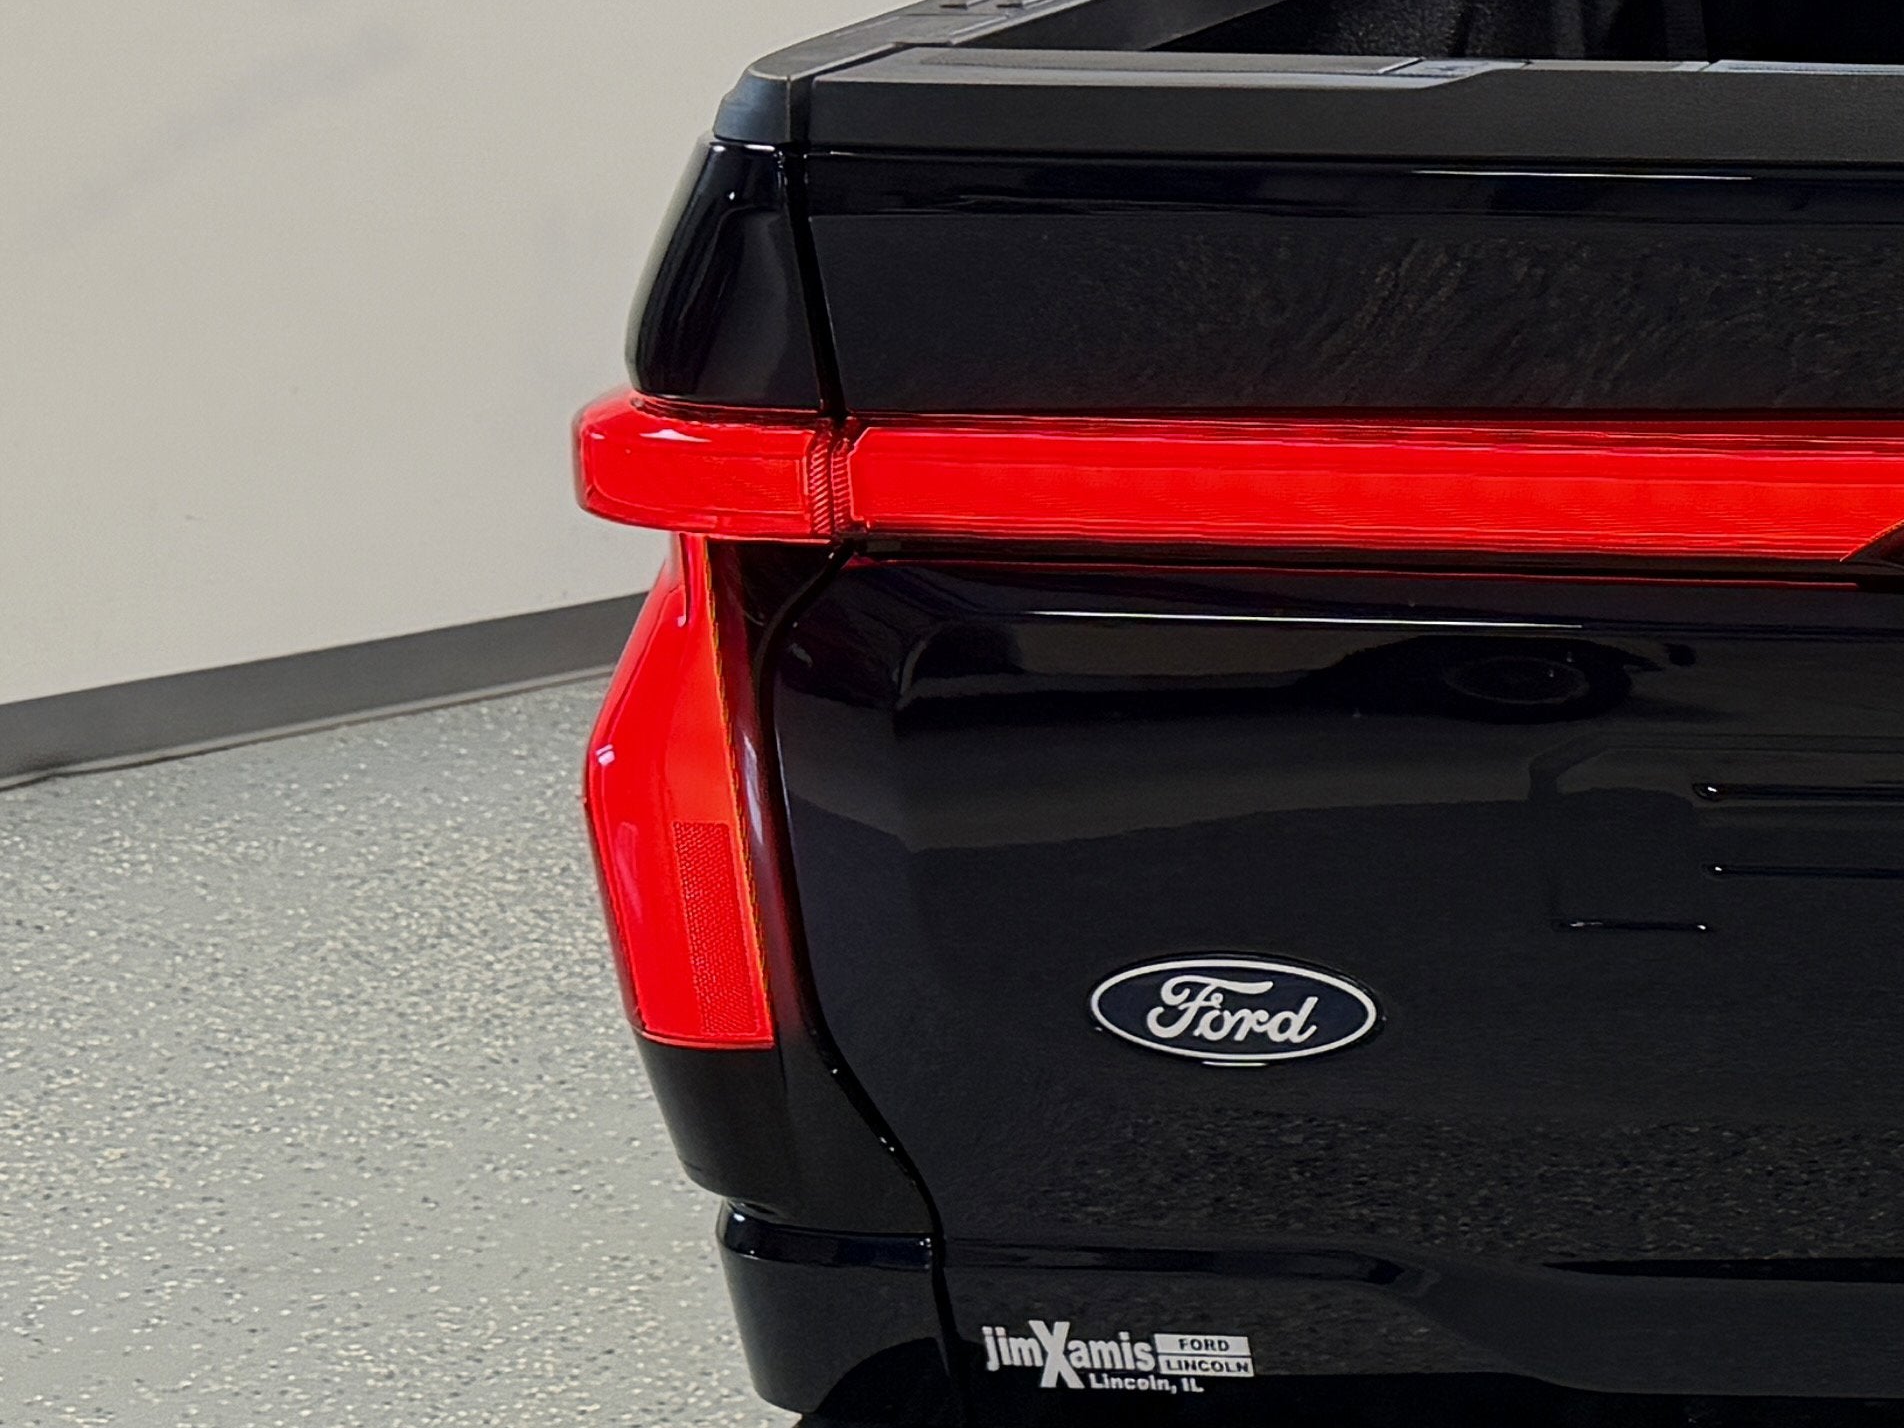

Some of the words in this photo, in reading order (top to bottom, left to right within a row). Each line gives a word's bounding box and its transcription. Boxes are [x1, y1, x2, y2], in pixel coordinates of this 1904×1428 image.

[1146, 974, 1319, 1044] Ford
[1177, 1337, 1231, 1352] FORD
[1165, 1358, 1250, 1374] LINCOLN
[1089, 1373, 1178, 1394] Lincoln,
[1181, 1377, 1204, 1392] IL
